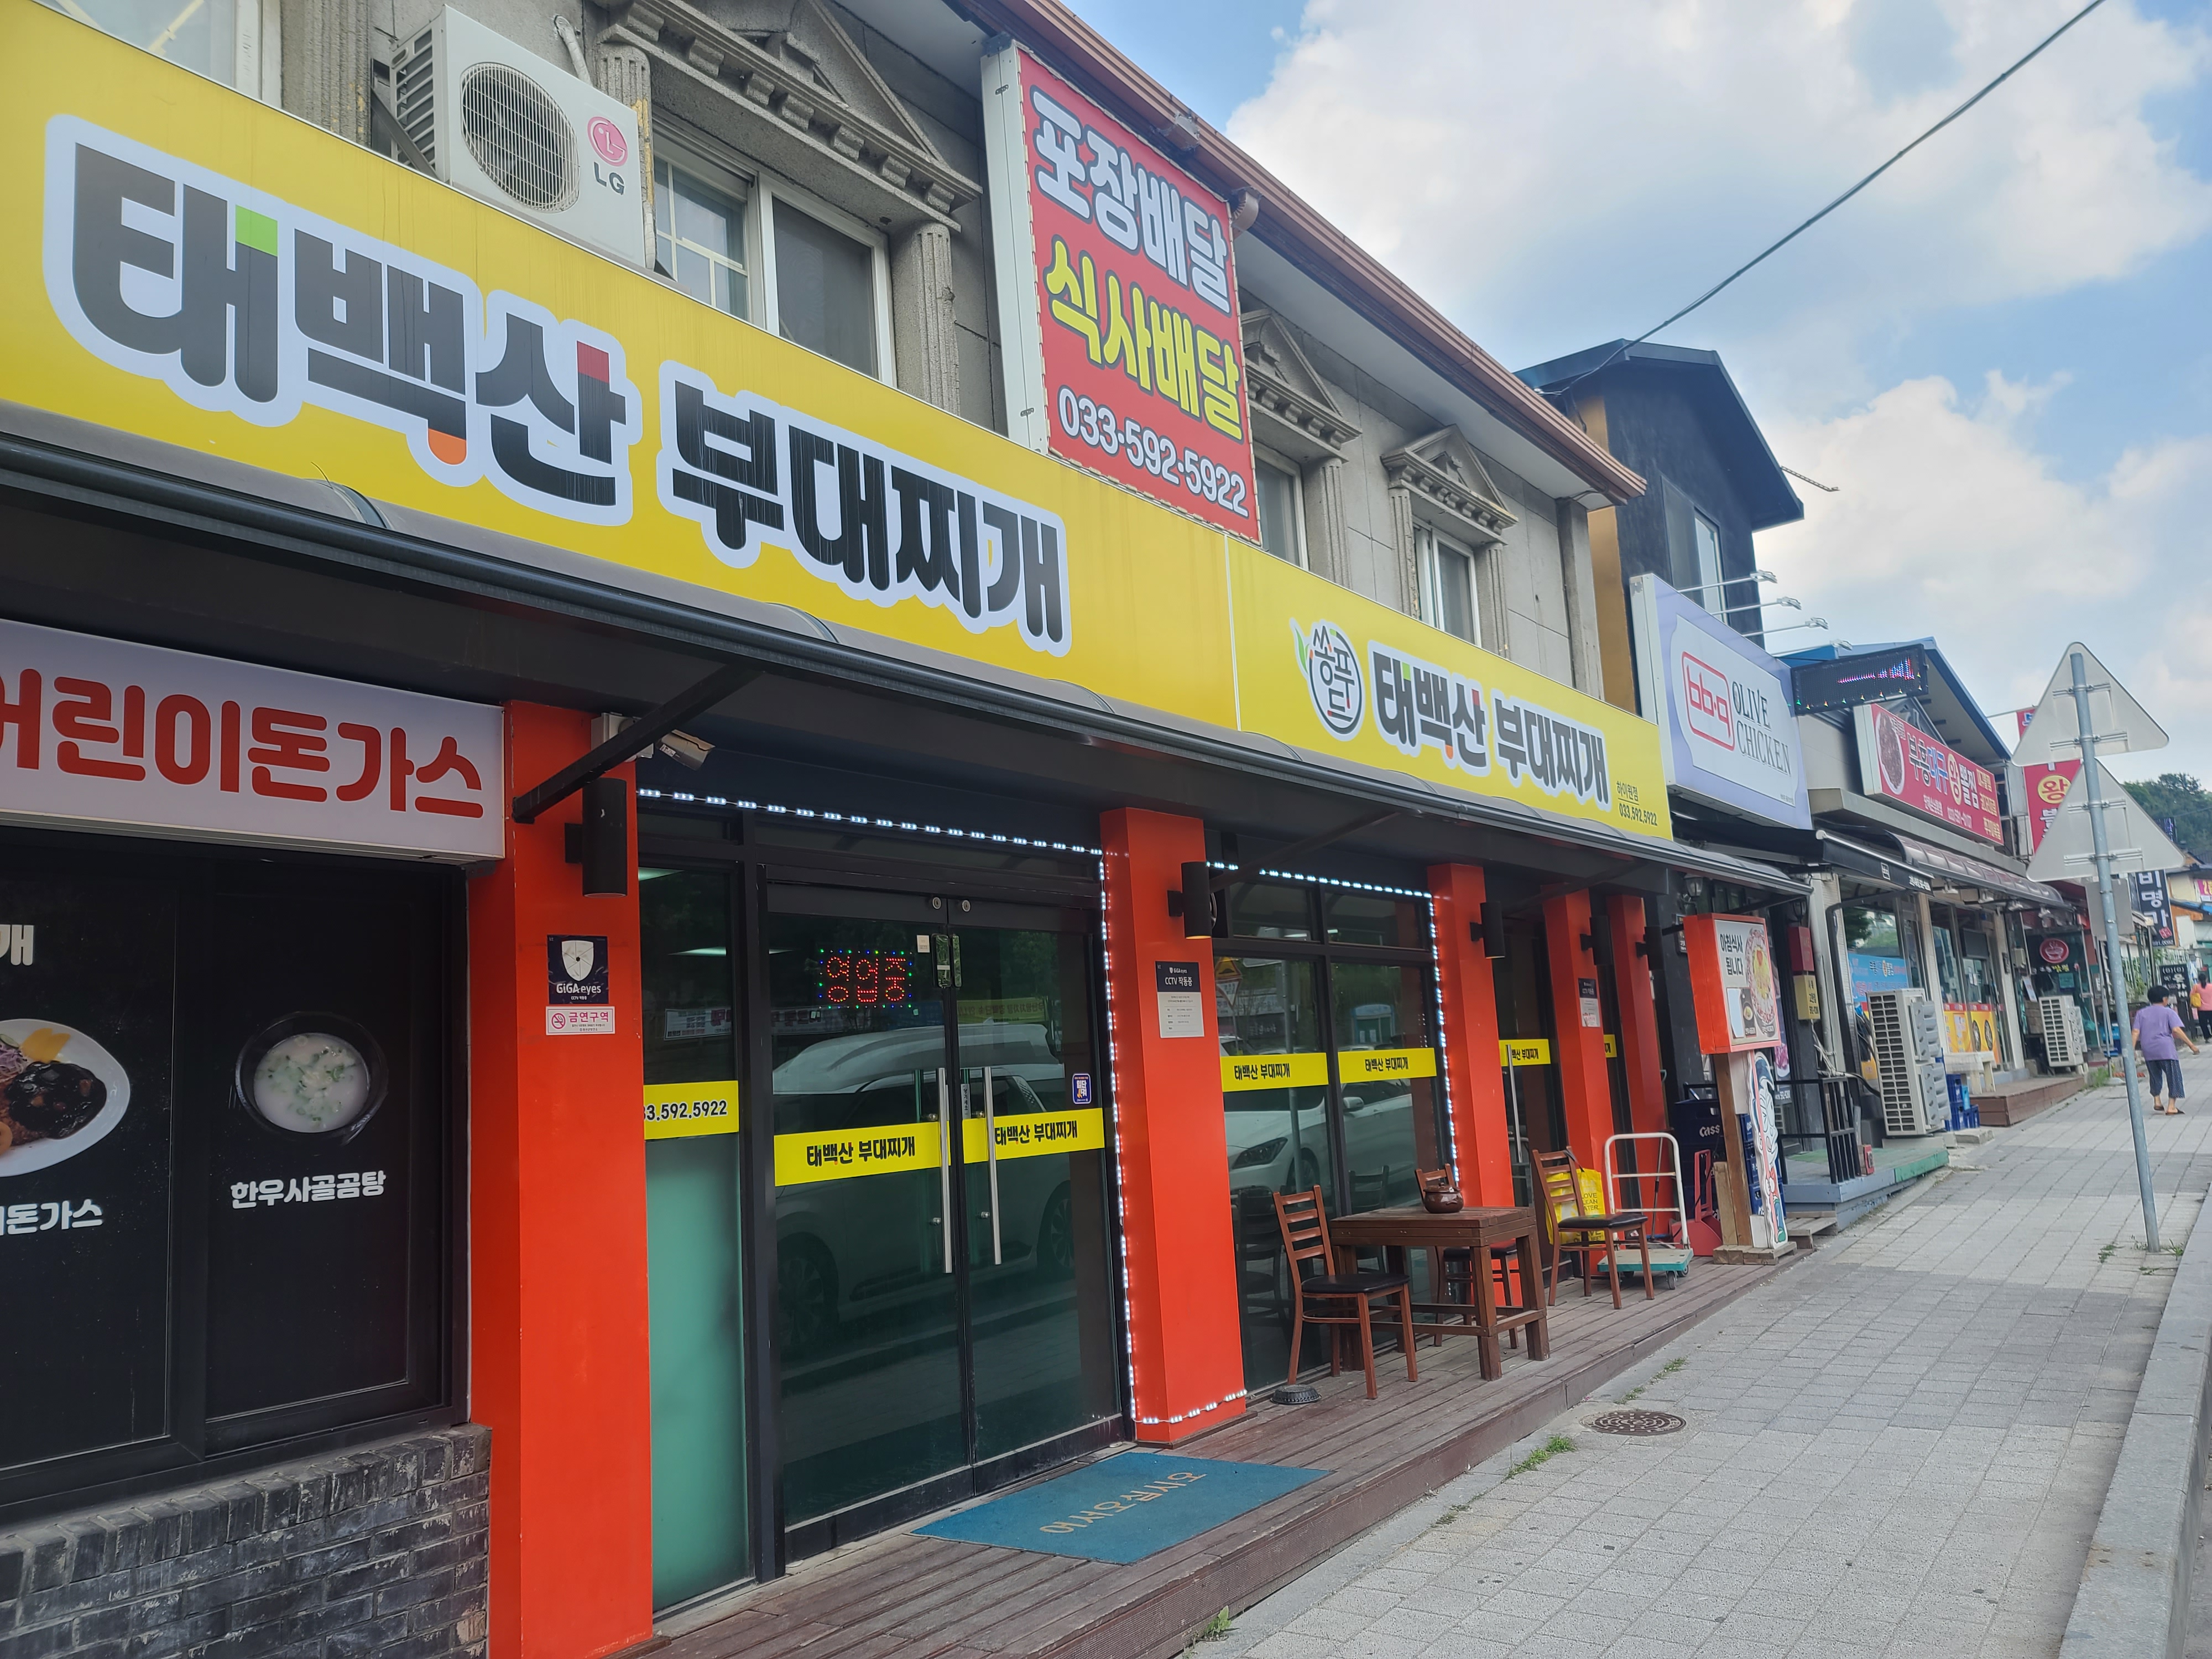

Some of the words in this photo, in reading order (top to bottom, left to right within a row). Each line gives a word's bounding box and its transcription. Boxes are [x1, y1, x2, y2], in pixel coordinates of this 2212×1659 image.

[594, 161, 625, 195] LG
[1033, 91, 1229, 314] 포장배달
[1048, 240, 1241, 439] 식사배달
[72, 142, 625, 506] 태백산
[672, 380, 1063, 643] 부대찌개
[1732, 681, 1771, 731] OLIVE
[1372, 651, 1486, 768] 태백산
[1494, 697, 1609, 804] 부대찌개
[1736, 719, 1792, 776] CHICKEN
[1616, 780, 1639, 802] 하이원점
[1619, 802, 1658, 826] 033.592.5922
[1720, 933, 1744, 953] 아침식사
[827, 955, 906, 1003] 영업중
[1726, 957, 1744, 975] 됩니다
[1165, 977, 1177, 985] CCTV
[1178, 977, 1192, 987] 작동중
[568, 1011, 608, 1022] 금연구역
[1365, 1057, 1384, 1072] 태백산
[1385, 1057, 1408, 1071] 부대찌개
[1511, 1049, 1521, 1061] 백산
[1234, 1063, 1258, 1081] 태백산
[1260, 1062, 1291, 1079] 부대찌개
[995, 1125, 1030, 1146] 태백산
[1034, 1120, 1078, 1142] 부대찌개
[1699, 1124, 1720, 1138] Cass
[806, 1142, 854, 1167] 태백산
[858, 1136, 915, 1162] 부대찌개
[231, 1170, 386, 1209] 한우사골곰탕
[0, 1198, 103, 1235] 돈가스
